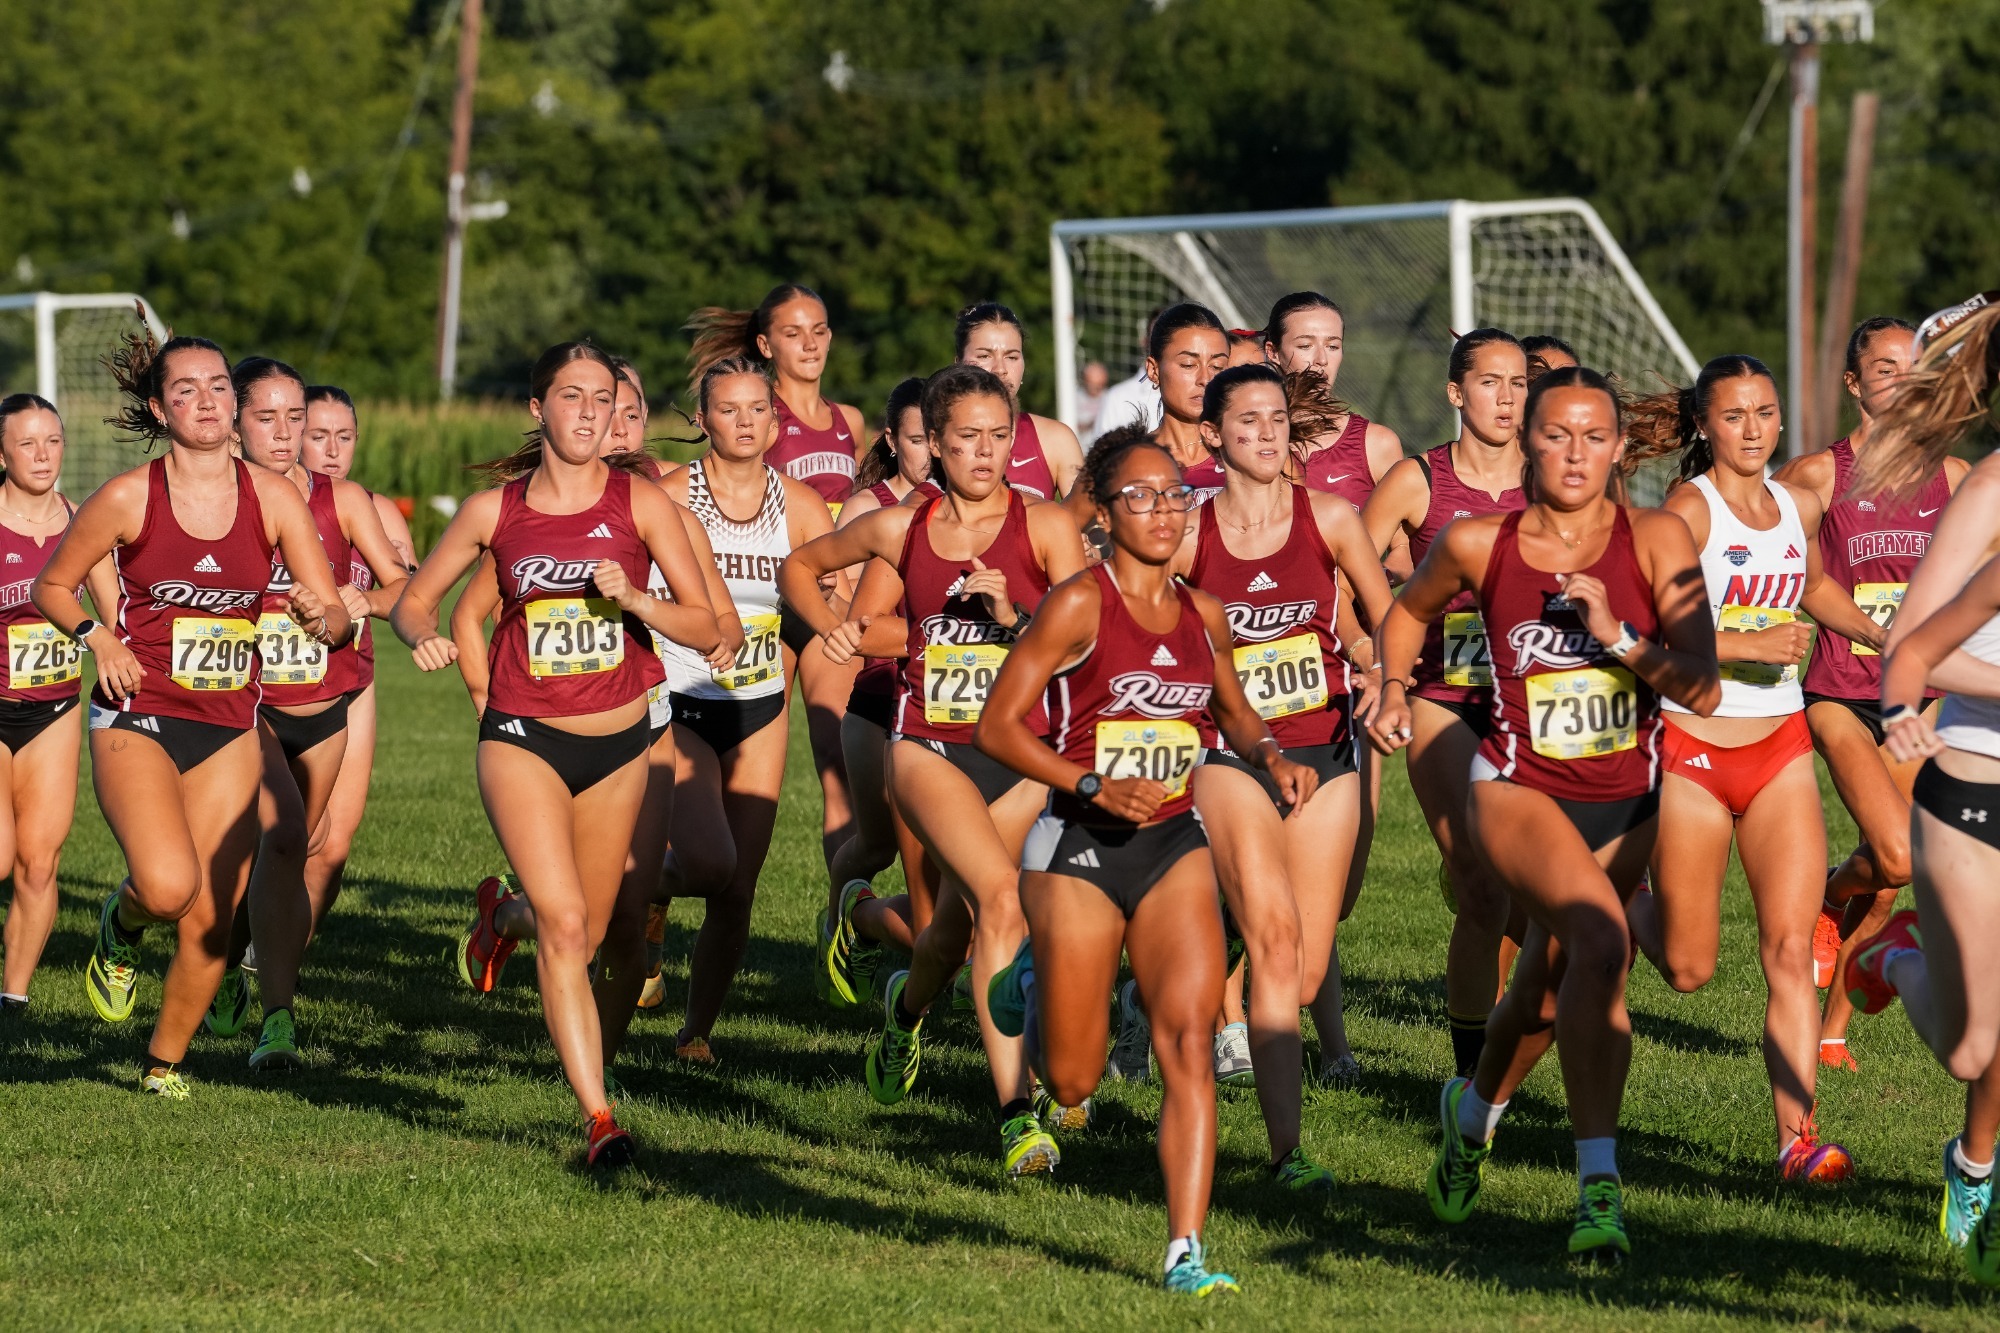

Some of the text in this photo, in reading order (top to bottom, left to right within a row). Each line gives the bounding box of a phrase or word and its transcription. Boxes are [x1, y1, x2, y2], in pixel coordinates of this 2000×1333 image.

[1848, 530, 1931, 566] LAFAYET
[194, 565, 222, 573] adidas
[511, 554, 601, 598] RIDE
[713, 552, 788, 582] EHIG
[1247, 581, 1278, 592] adidas
[533, 618, 618, 656] 7303
[1224, 600, 1317, 642] RIDER
[14, 637, 80, 672] 7263
[178, 638, 249, 672] 7296
[717, 630, 777, 674] 276
[1449, 633, 1491, 667] 72
[1506, 620, 1608, 676] RIDE
[930, 667, 1002, 703] 729
[1536, 690, 1630, 739] 7300
[1104, 744, 1194, 782] 7305
